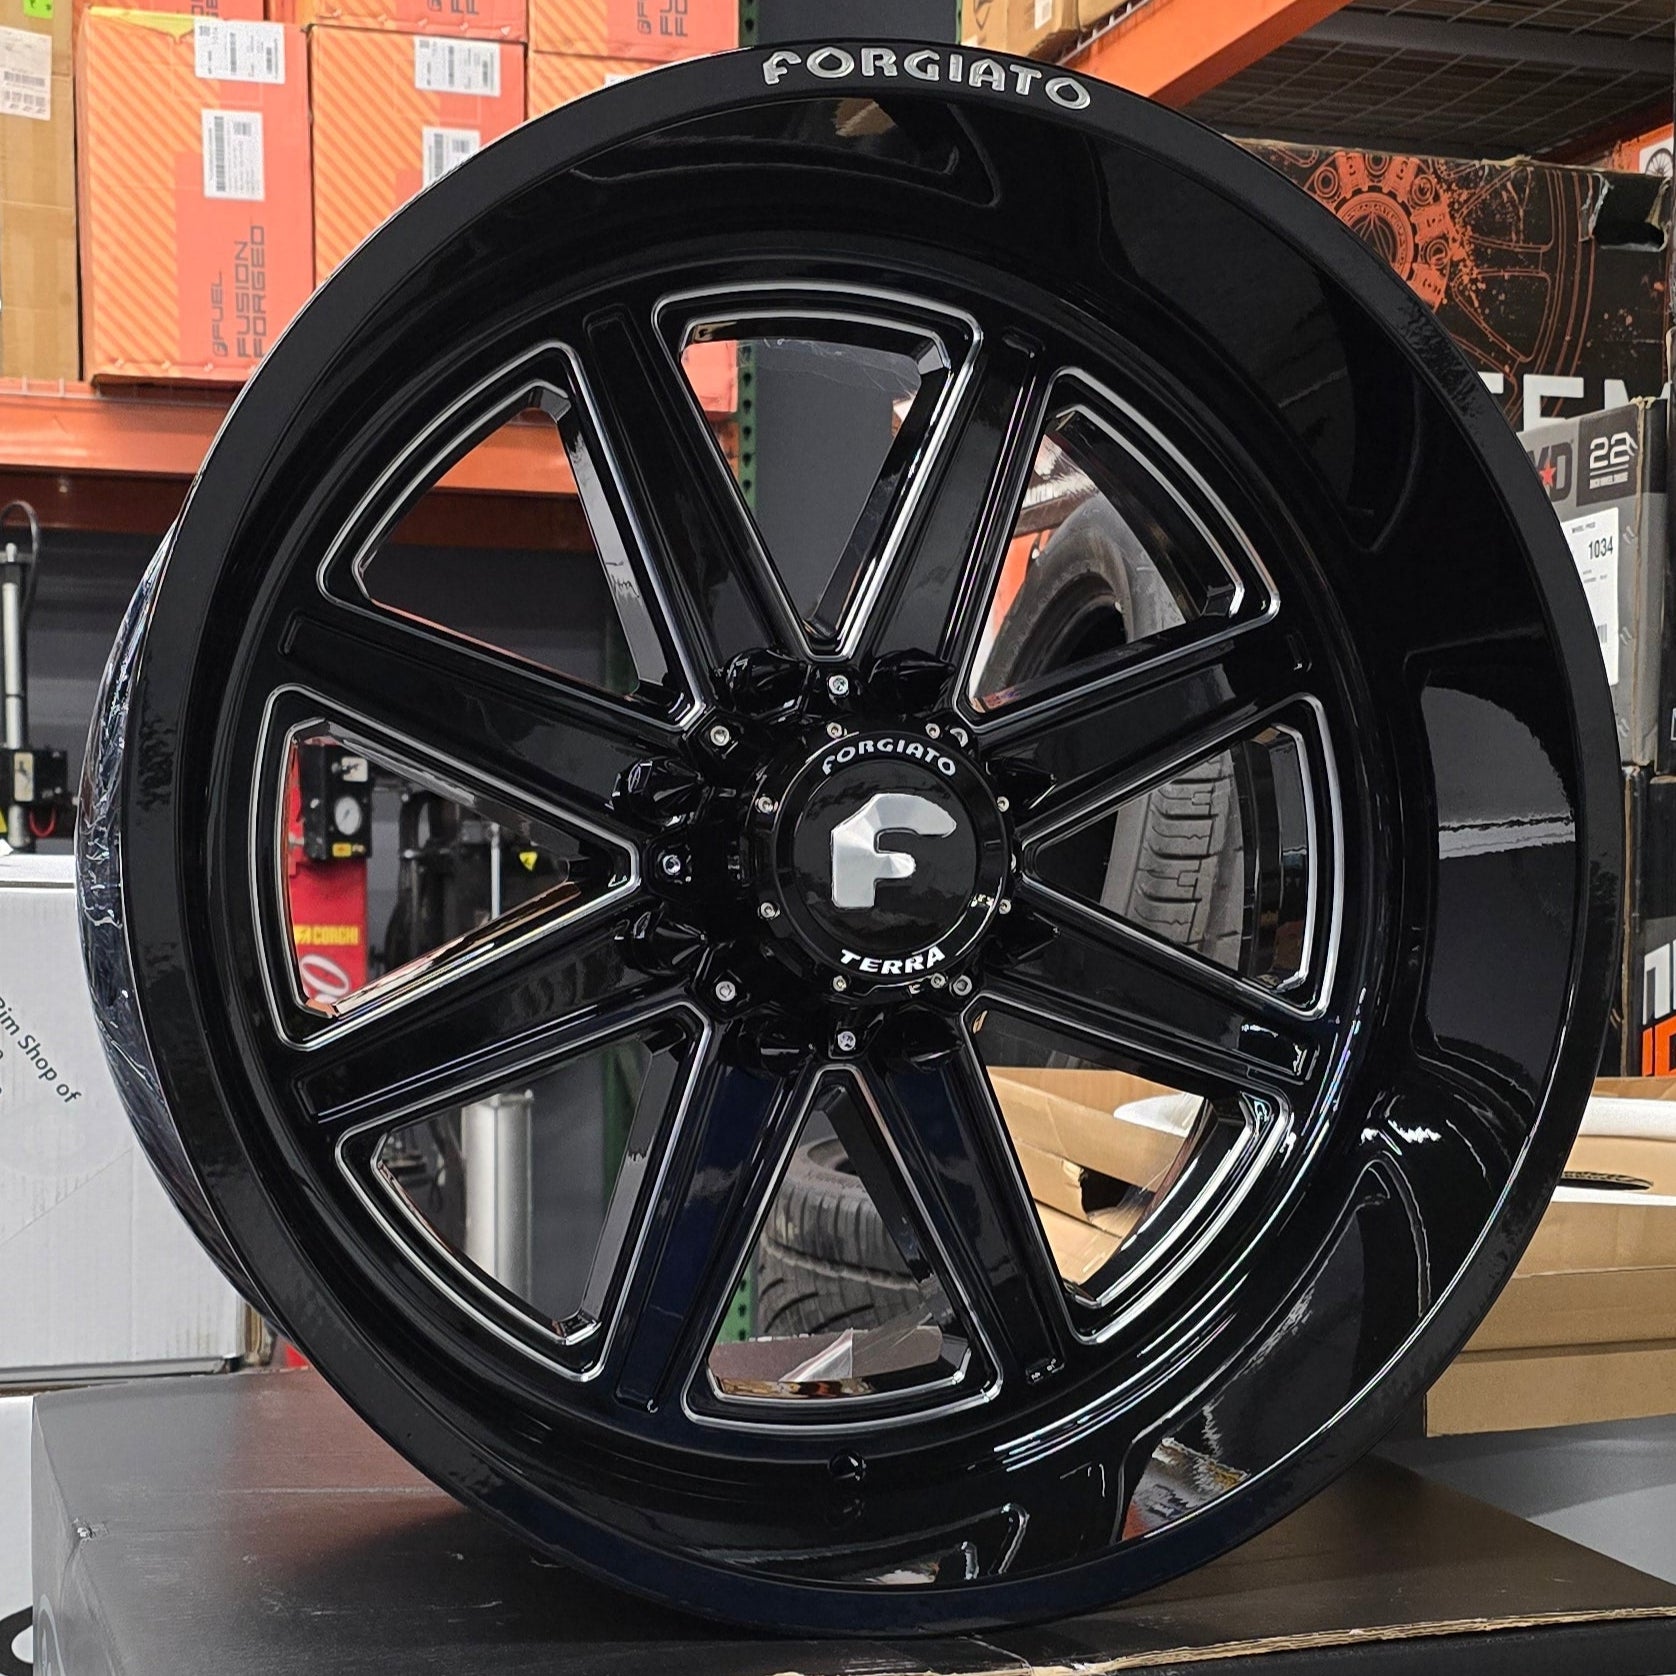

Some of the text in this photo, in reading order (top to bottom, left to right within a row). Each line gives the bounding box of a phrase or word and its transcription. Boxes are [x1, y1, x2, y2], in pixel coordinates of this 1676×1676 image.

[762, 46, 1091, 110] FORGIATO
[211, 267, 224, 341] FUEL
[234, 241, 251, 358] FUSION
[250, 225, 266, 358] FORGED
[1590, 431, 1638, 469] 22
[1588, 535, 1613, 560] 1034
[822, 738, 956, 777] FORGIATO
[840, 946, 945, 975] TERRA
[17, 1034, 58, 1082] Shop
[56, 1083, 82, 1103] of
